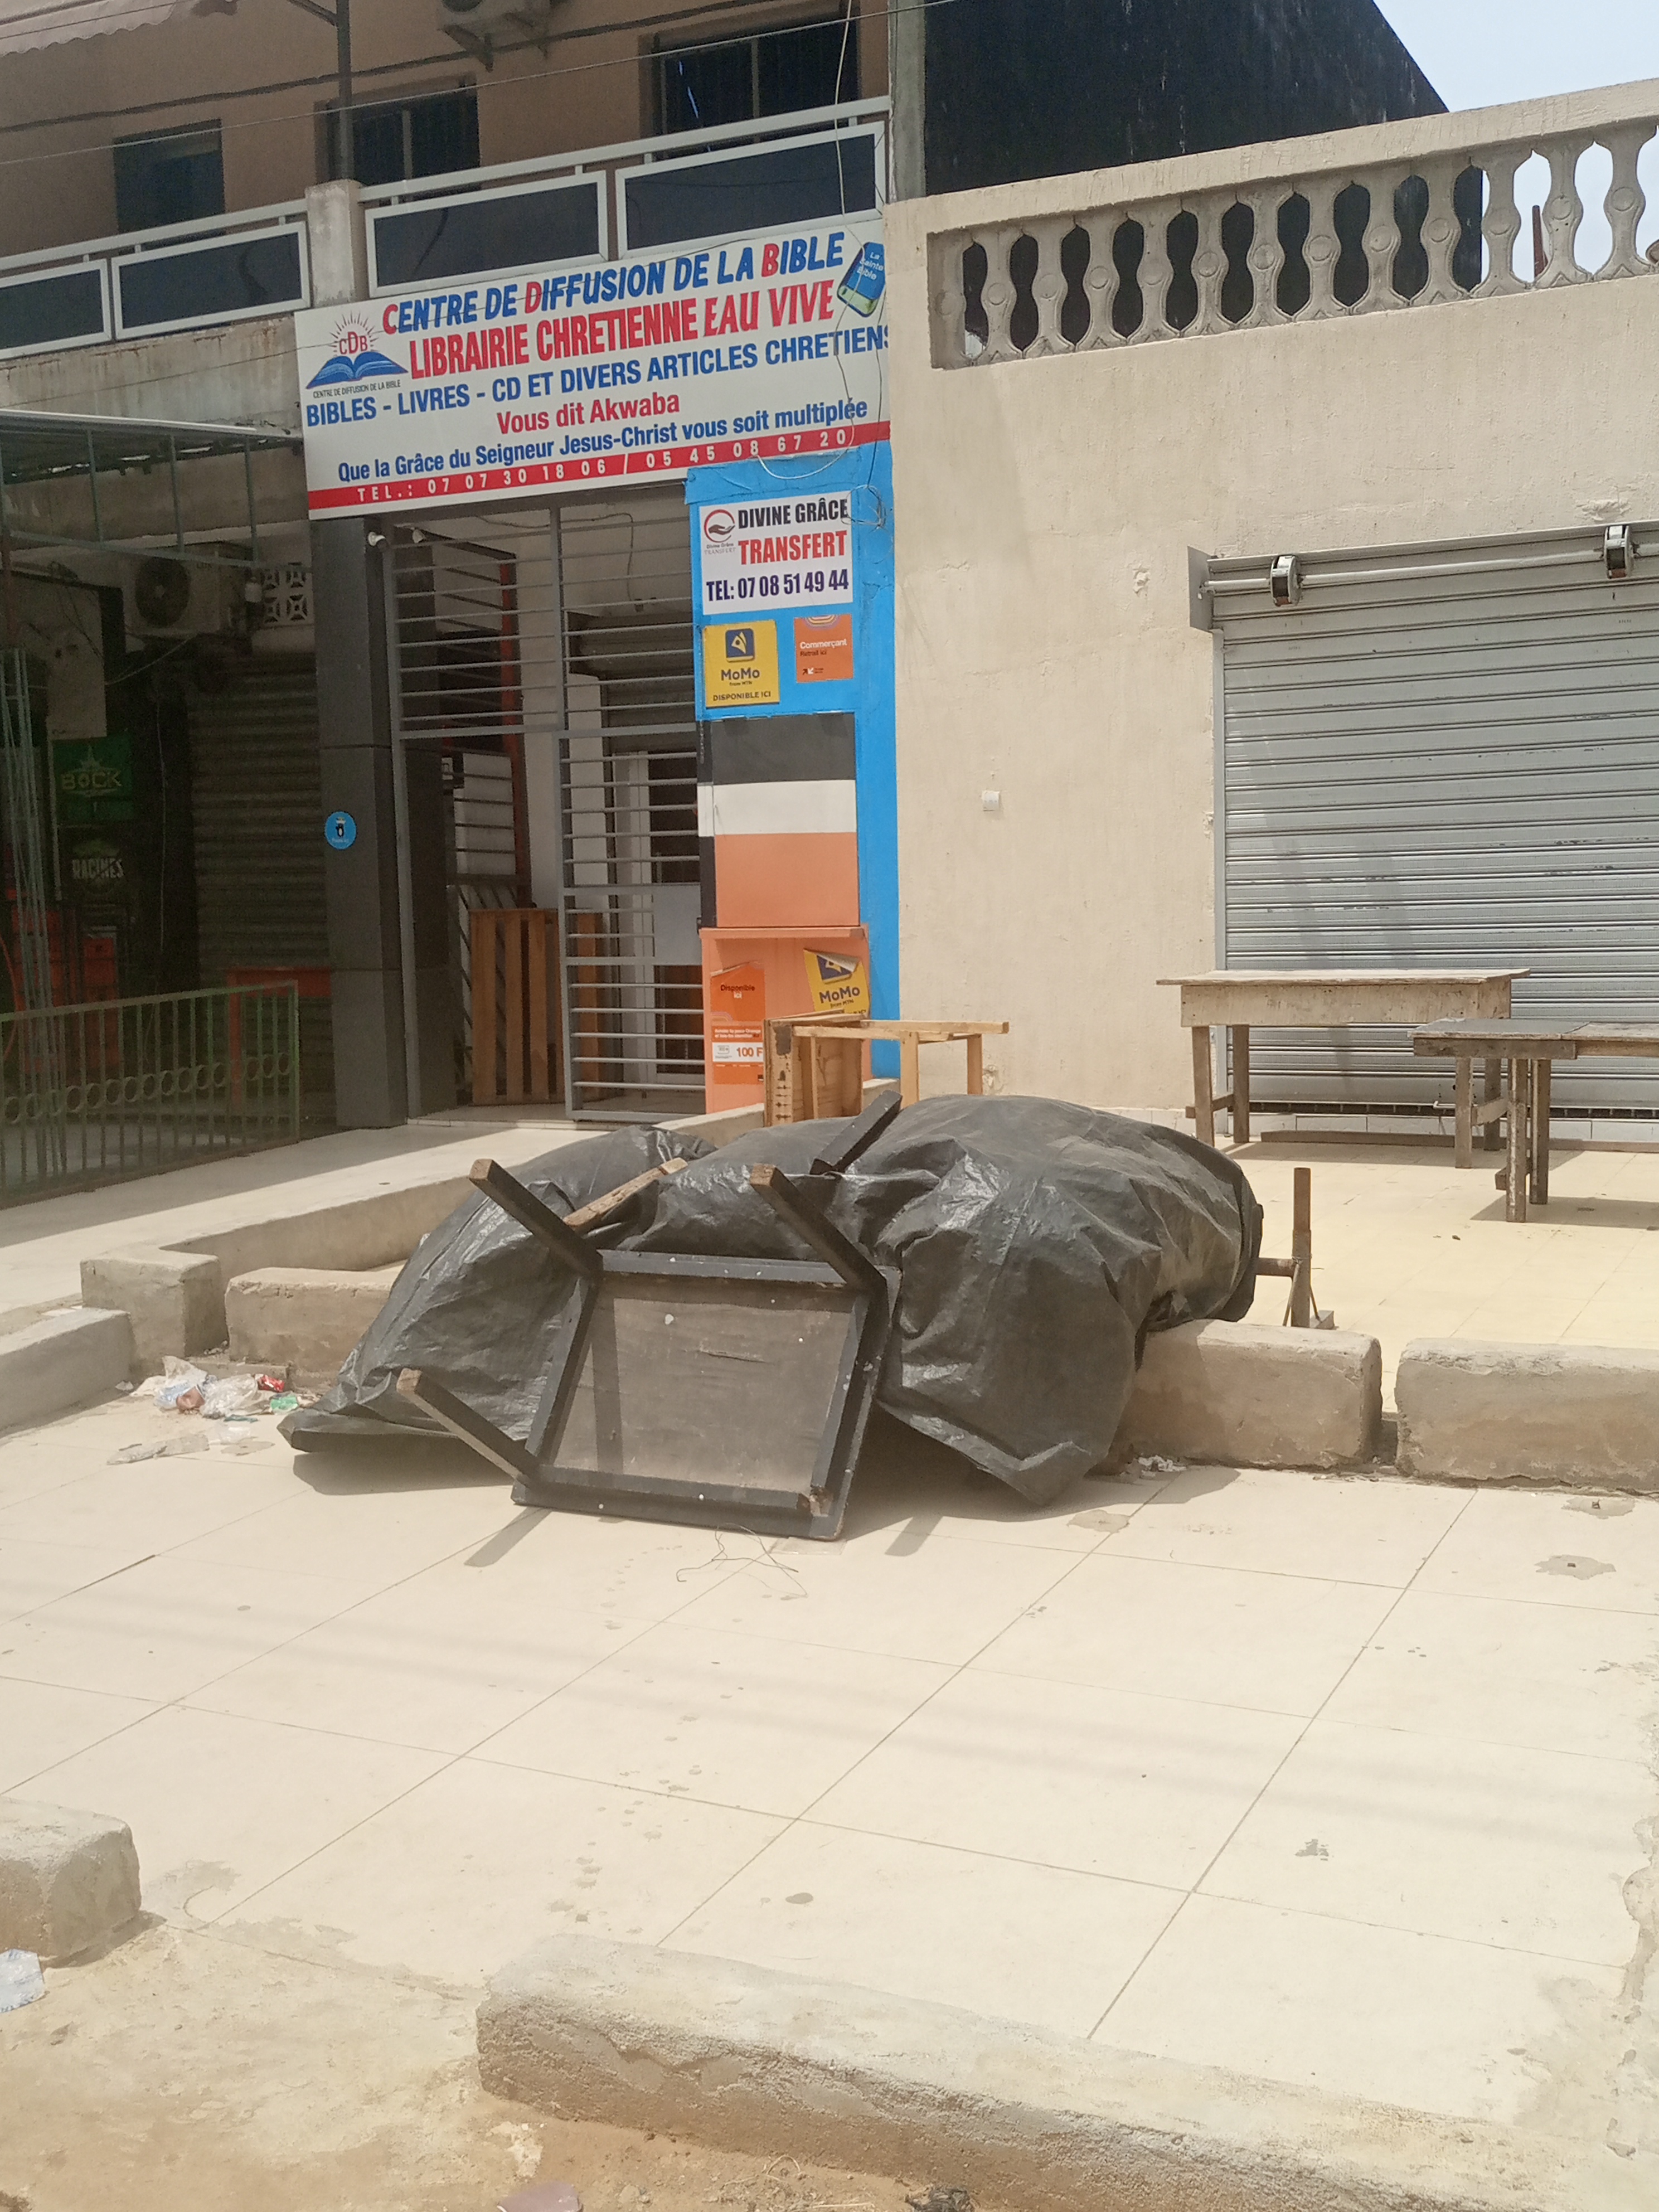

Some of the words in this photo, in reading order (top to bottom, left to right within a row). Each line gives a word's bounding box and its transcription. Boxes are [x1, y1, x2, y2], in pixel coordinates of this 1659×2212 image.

[382, 291, 478, 334] CENTRE
[484, 284, 518, 320] DE
[524, 261, 666, 313] DIFFUSION
[674, 254, 710, 291] DE
[717, 247, 754, 284] LA
[761, 232, 845, 277] BIBLE
[410, 323, 530, 379] LIBRAIRIE
[537, 298, 698, 361] CHRETIENNE
[703, 291, 760, 337] EAU
[768, 280, 835, 327] VIVE
[339, 331, 368, 355] CDB
[306, 397, 377, 426] BIBLES
[399, 385, 469, 415] LIVRES
[492, 377, 521, 402] CD
[528, 372, 553, 397] ET
[561, 360, 642, 394] DIVERS
[647, 343, 758, 381] ARTICLES
[313, 390, 333, 398] CENTRE
[342, 385, 369, 395] DIFFUSION
[386, 380, 401, 388] BIBLE
[497, 412, 549, 434] Vous
[556, 404, 584, 428] dit
[590, 392, 680, 423] Akwaba
[338, 463, 369, 483] Que
[375, 459, 390, 477] la
[396, 454, 444, 474] Grâce
[450, 449, 471, 471] du
[476, 440, 555, 467] Seigneur
[560, 424, 677, 455] Jesus-Christ
[682, 420, 727, 438] vous
[733, 410, 769, 434] soit
[775, 398, 867, 428] multiplée
[358, 486, 413, 502] TEL.:
[428, 479, 450, 493] 07
[465, 473, 488, 488] 07
[503, 468, 527, 485] 30
[542, 463, 564, 481] 18
[581, 455, 605, 475] 06
[623, 454, 629, 474] /
[647, 452, 671, 467] 05
[690, 447, 715, 463] 45
[734, 440, 759, 457] 08
[778, 435, 802, 452] 67
[820, 429, 846, 446] 20
[738, 505, 791, 529] DIVINE
[795, 498, 848, 523] GRÂCE
[738, 531, 847, 565] TRANSFERT
[706, 579, 734, 601] TEL:
[738, 578, 755, 599] 07
[759, 575, 779, 596] 08
[784, 573, 801, 594] 51
[804, 571, 824, 592] 49
[828, 569, 849, 590] 44
[800, 638, 847, 649] Commerçant
[721, 667, 760, 681] MoMo
[713, 692, 759, 701] DISPONIBLE
[61, 768, 122, 792] BOCK
[72, 857, 124, 880] RACINES
[720, 984, 755, 992] Disponible
[819, 986, 860, 1003] MoMo
[736, 1047, 754, 1057] 100
[756, 1047, 763, 1057] F
